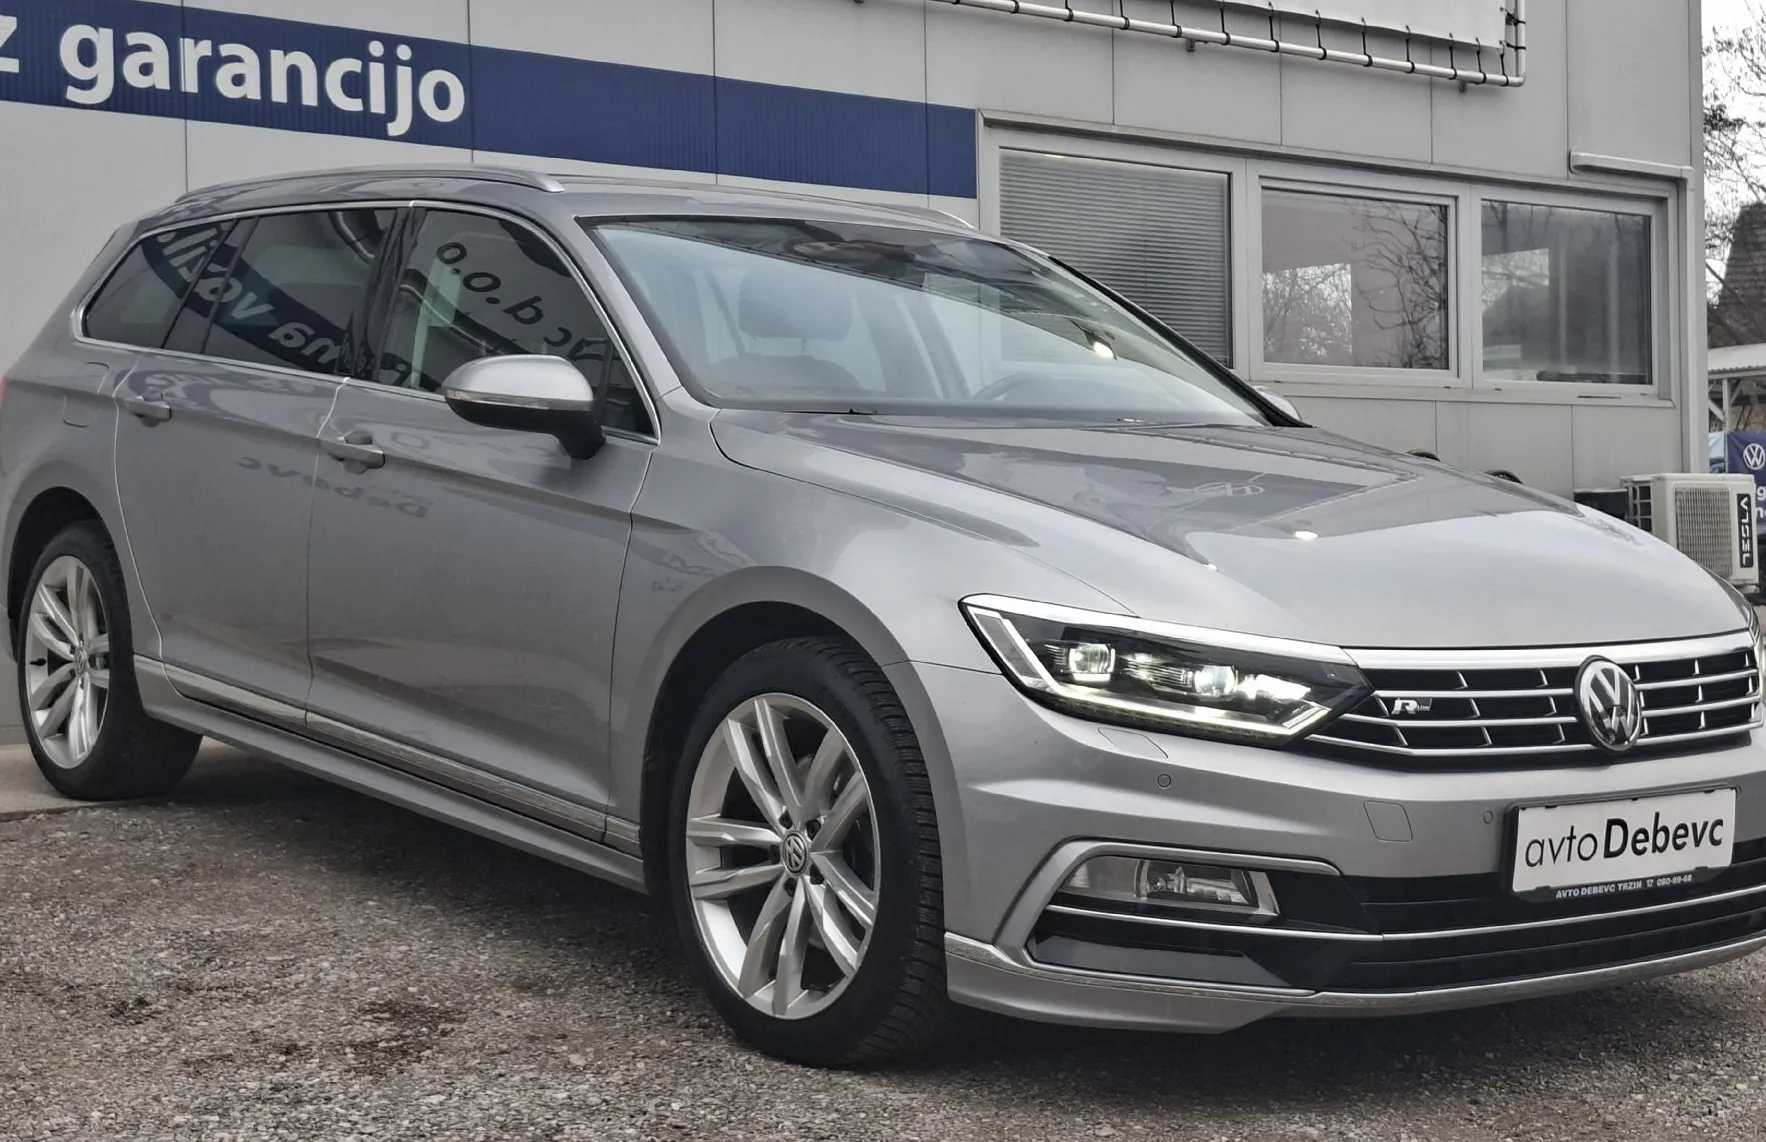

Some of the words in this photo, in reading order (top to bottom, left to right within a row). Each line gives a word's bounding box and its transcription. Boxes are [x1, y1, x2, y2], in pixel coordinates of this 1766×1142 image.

[60, 24, 466, 137] garancijo
[1556, 888, 1580, 899] AVTO
[1581, 883, 1616, 896] DEBEVC
